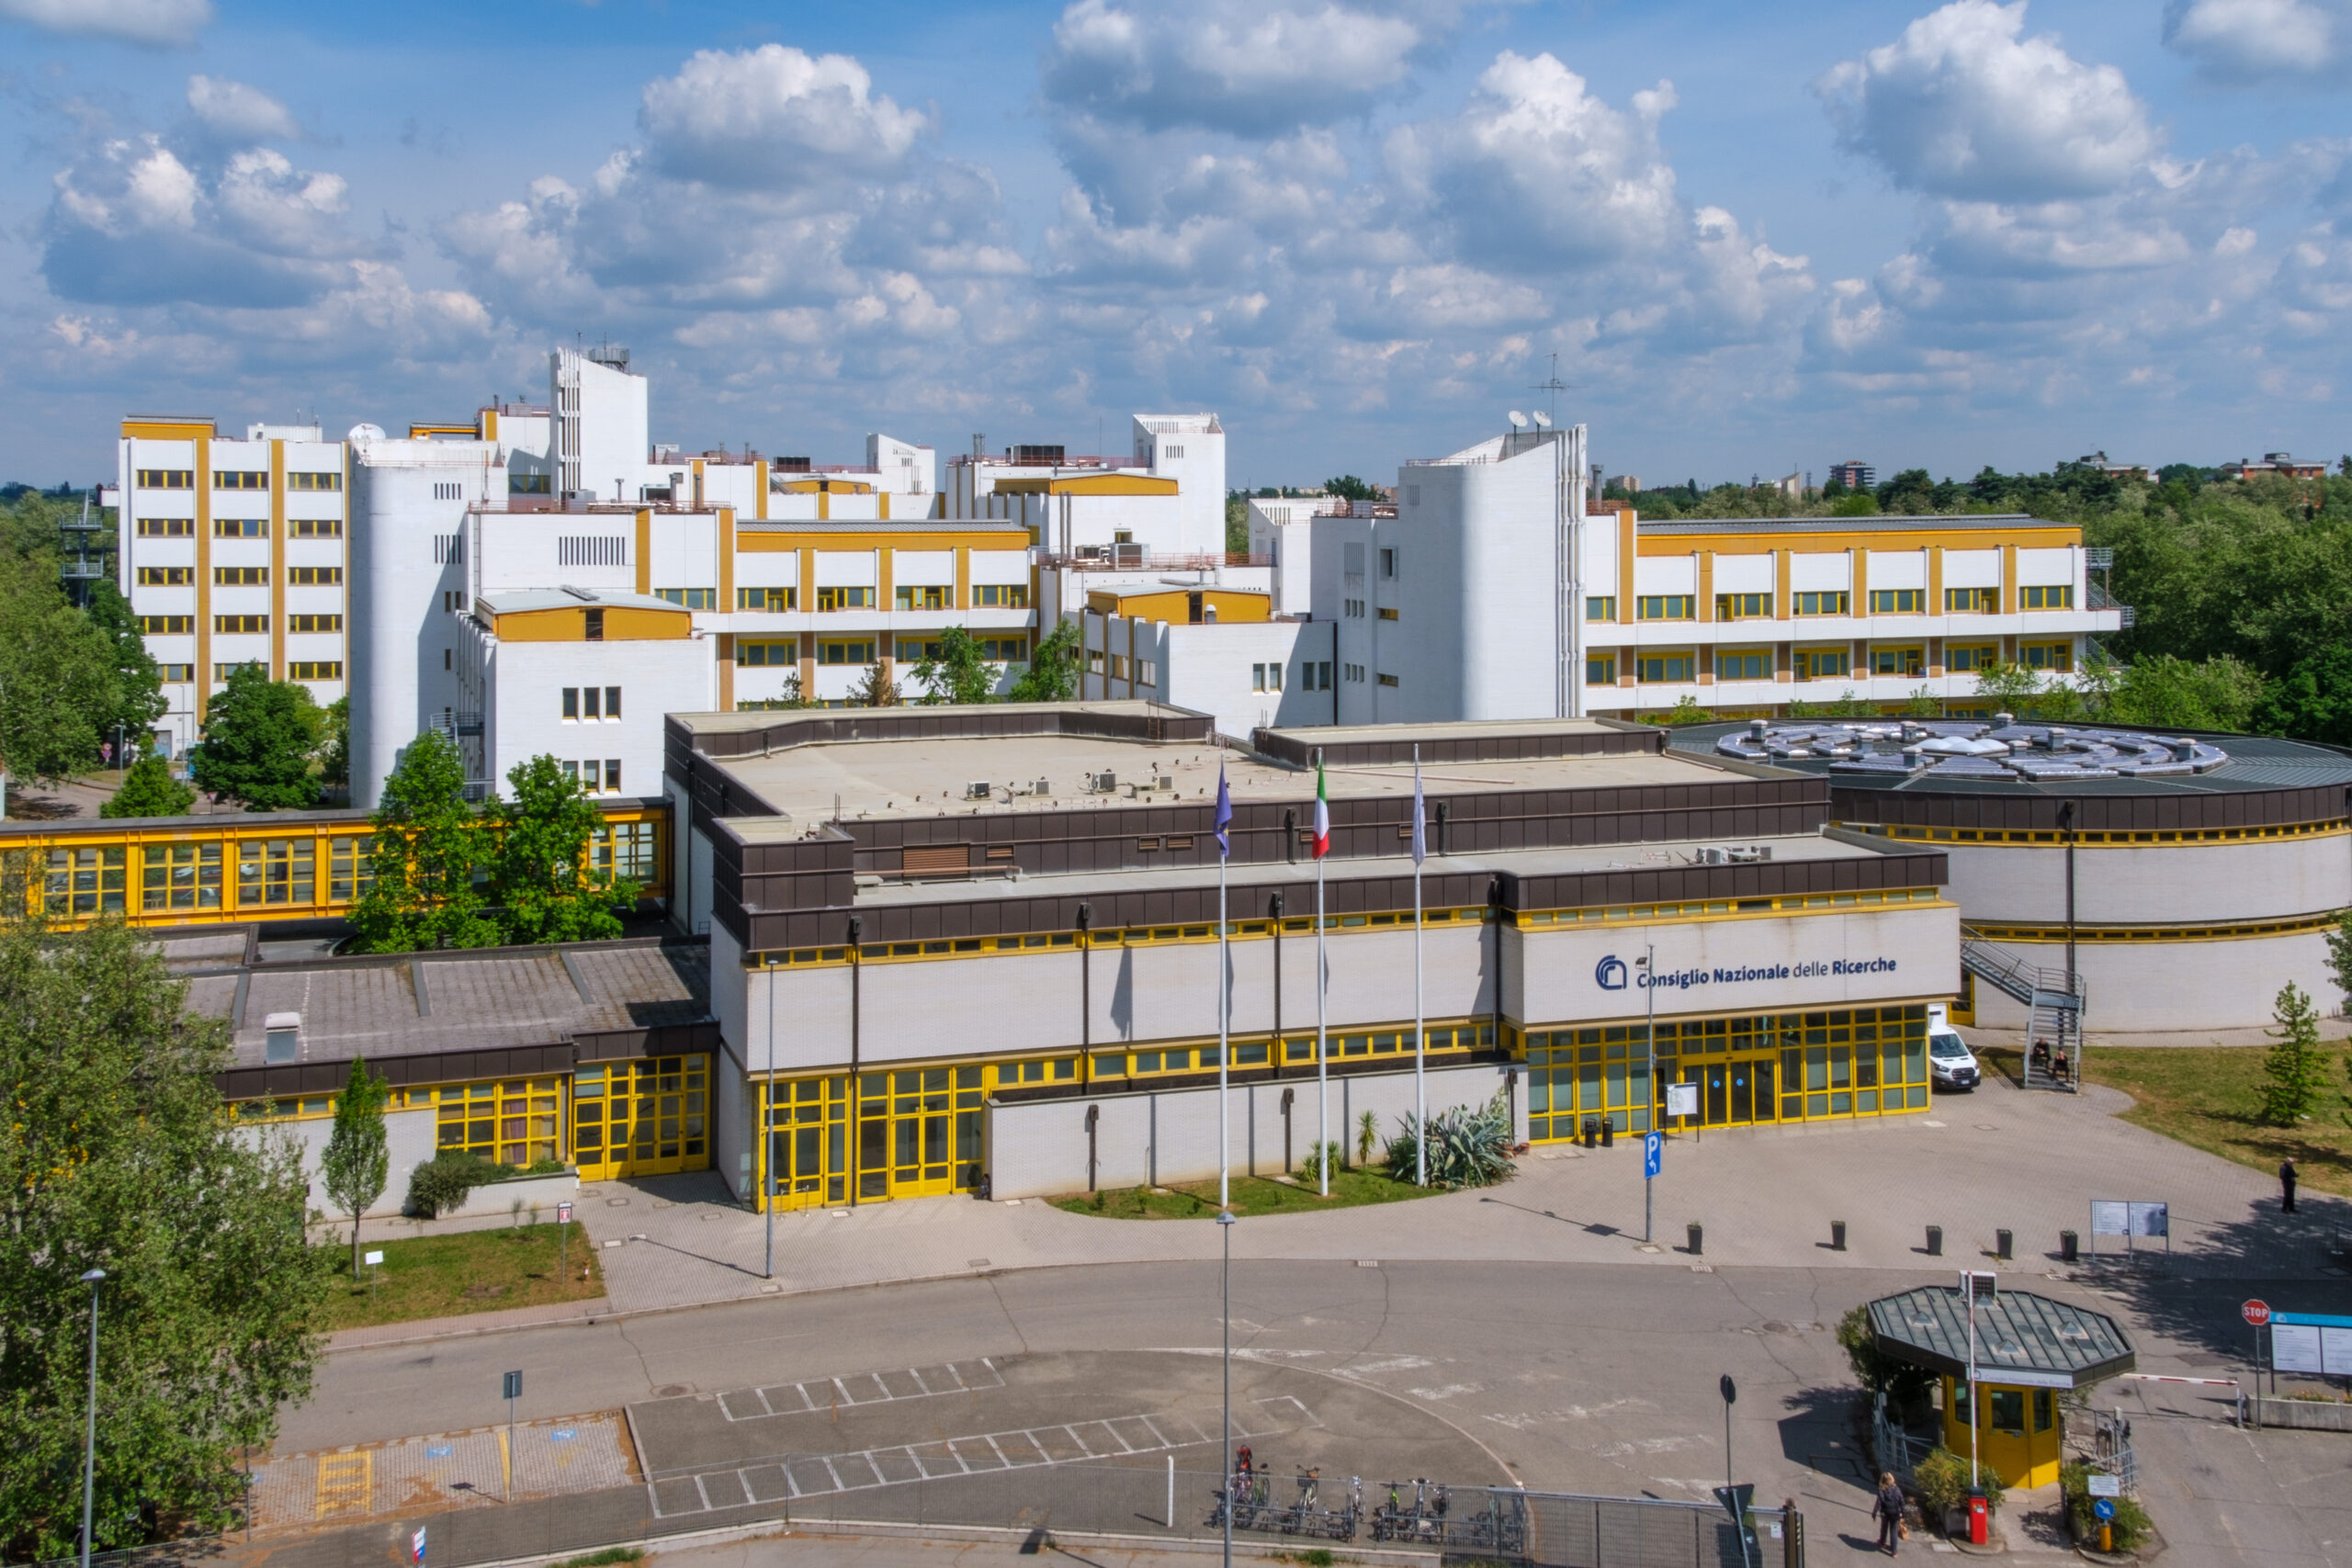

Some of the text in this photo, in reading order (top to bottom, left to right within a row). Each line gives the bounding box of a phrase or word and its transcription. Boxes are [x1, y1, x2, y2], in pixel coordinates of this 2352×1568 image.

[1637, 957, 1897, 989] Consiglio Nazionale delle Ricerche
[1647, 1135, 1658, 1160] P
[2244, 1306, 2268, 1317] STOP
